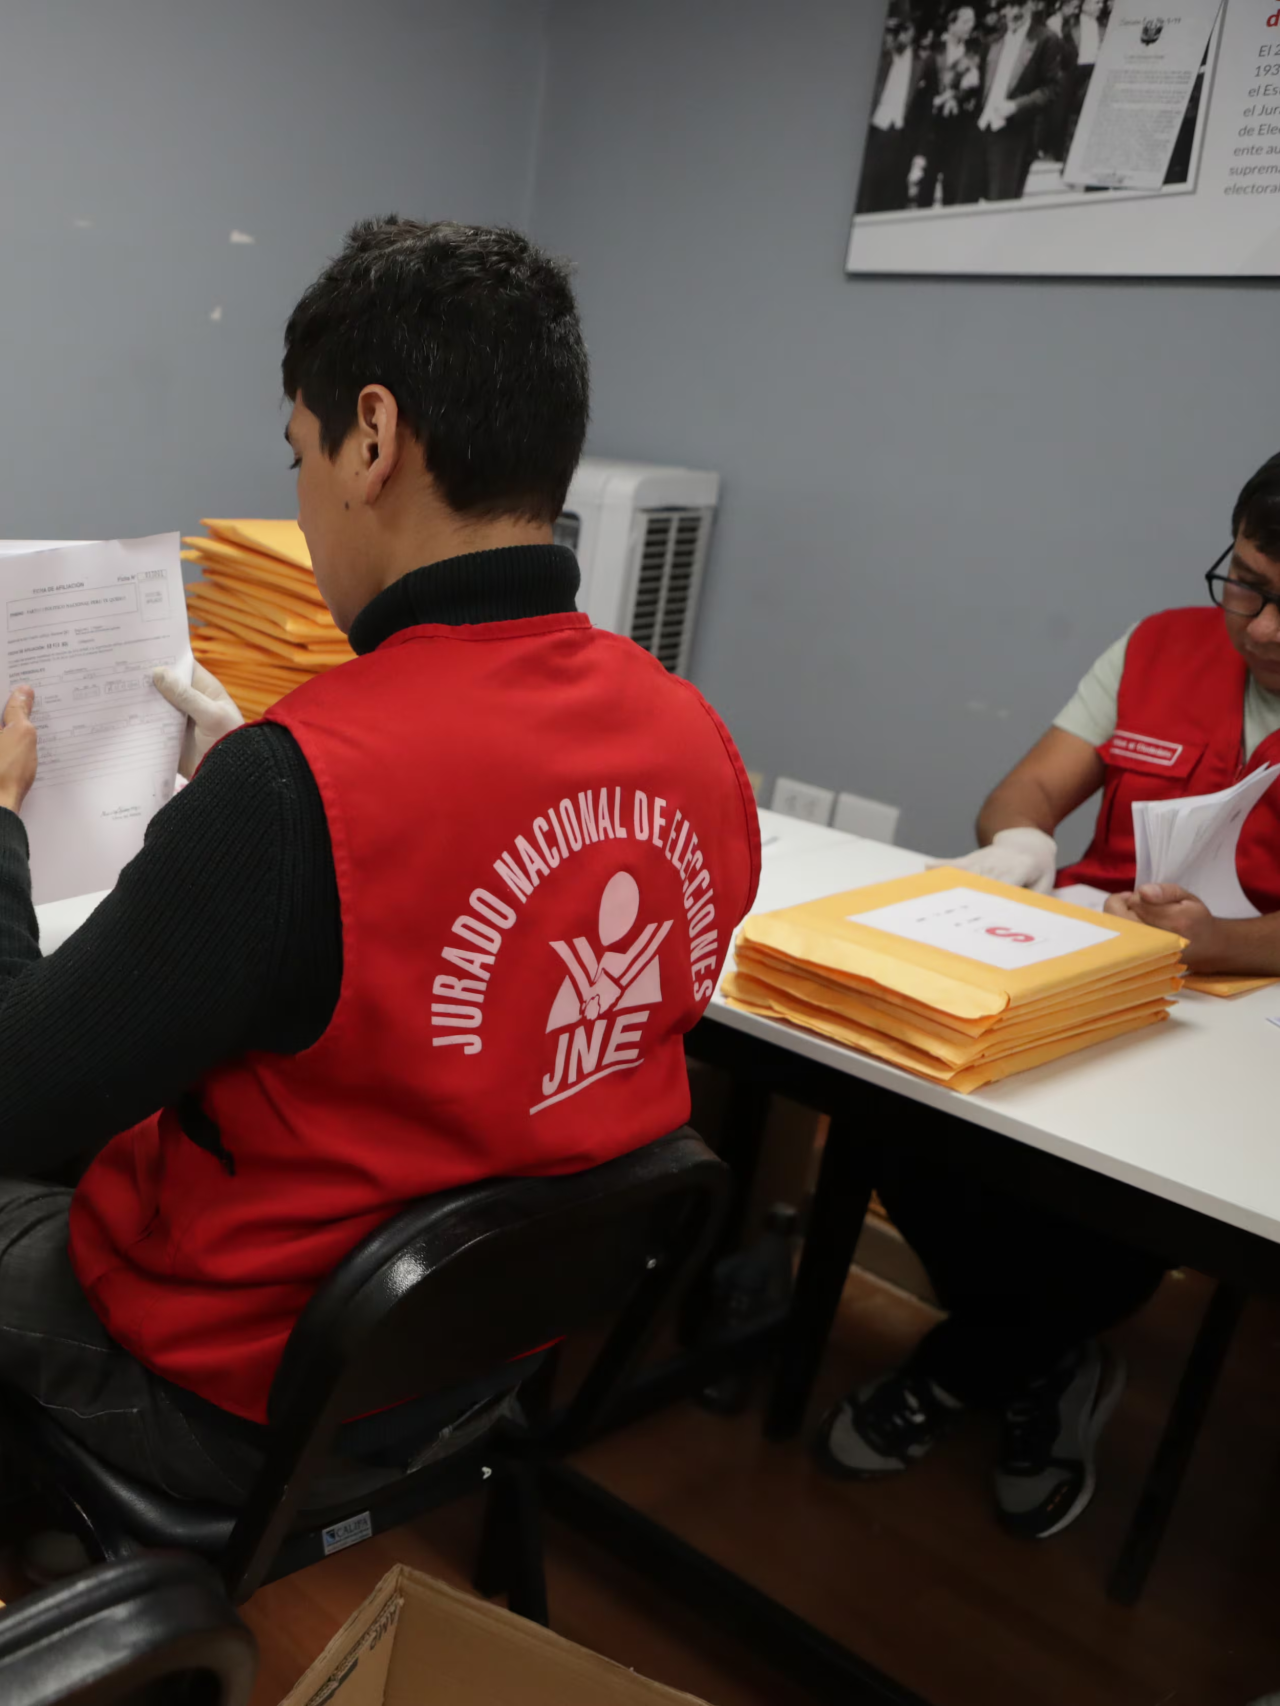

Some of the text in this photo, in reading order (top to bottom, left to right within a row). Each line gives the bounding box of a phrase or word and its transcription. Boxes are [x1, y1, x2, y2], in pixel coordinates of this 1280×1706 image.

[1258, 44, 1272, 58] El
[1248, 83, 1280, 98] el Es
[1243, 104, 1256, 118] el
[1237, 124, 1255, 138] de
[1233, 143, 1264, 157] ente
[431, 786, 719, 1055] JURADO NACIONAL DE ELECCIONES
[542, 1010, 650, 1096] JNE
